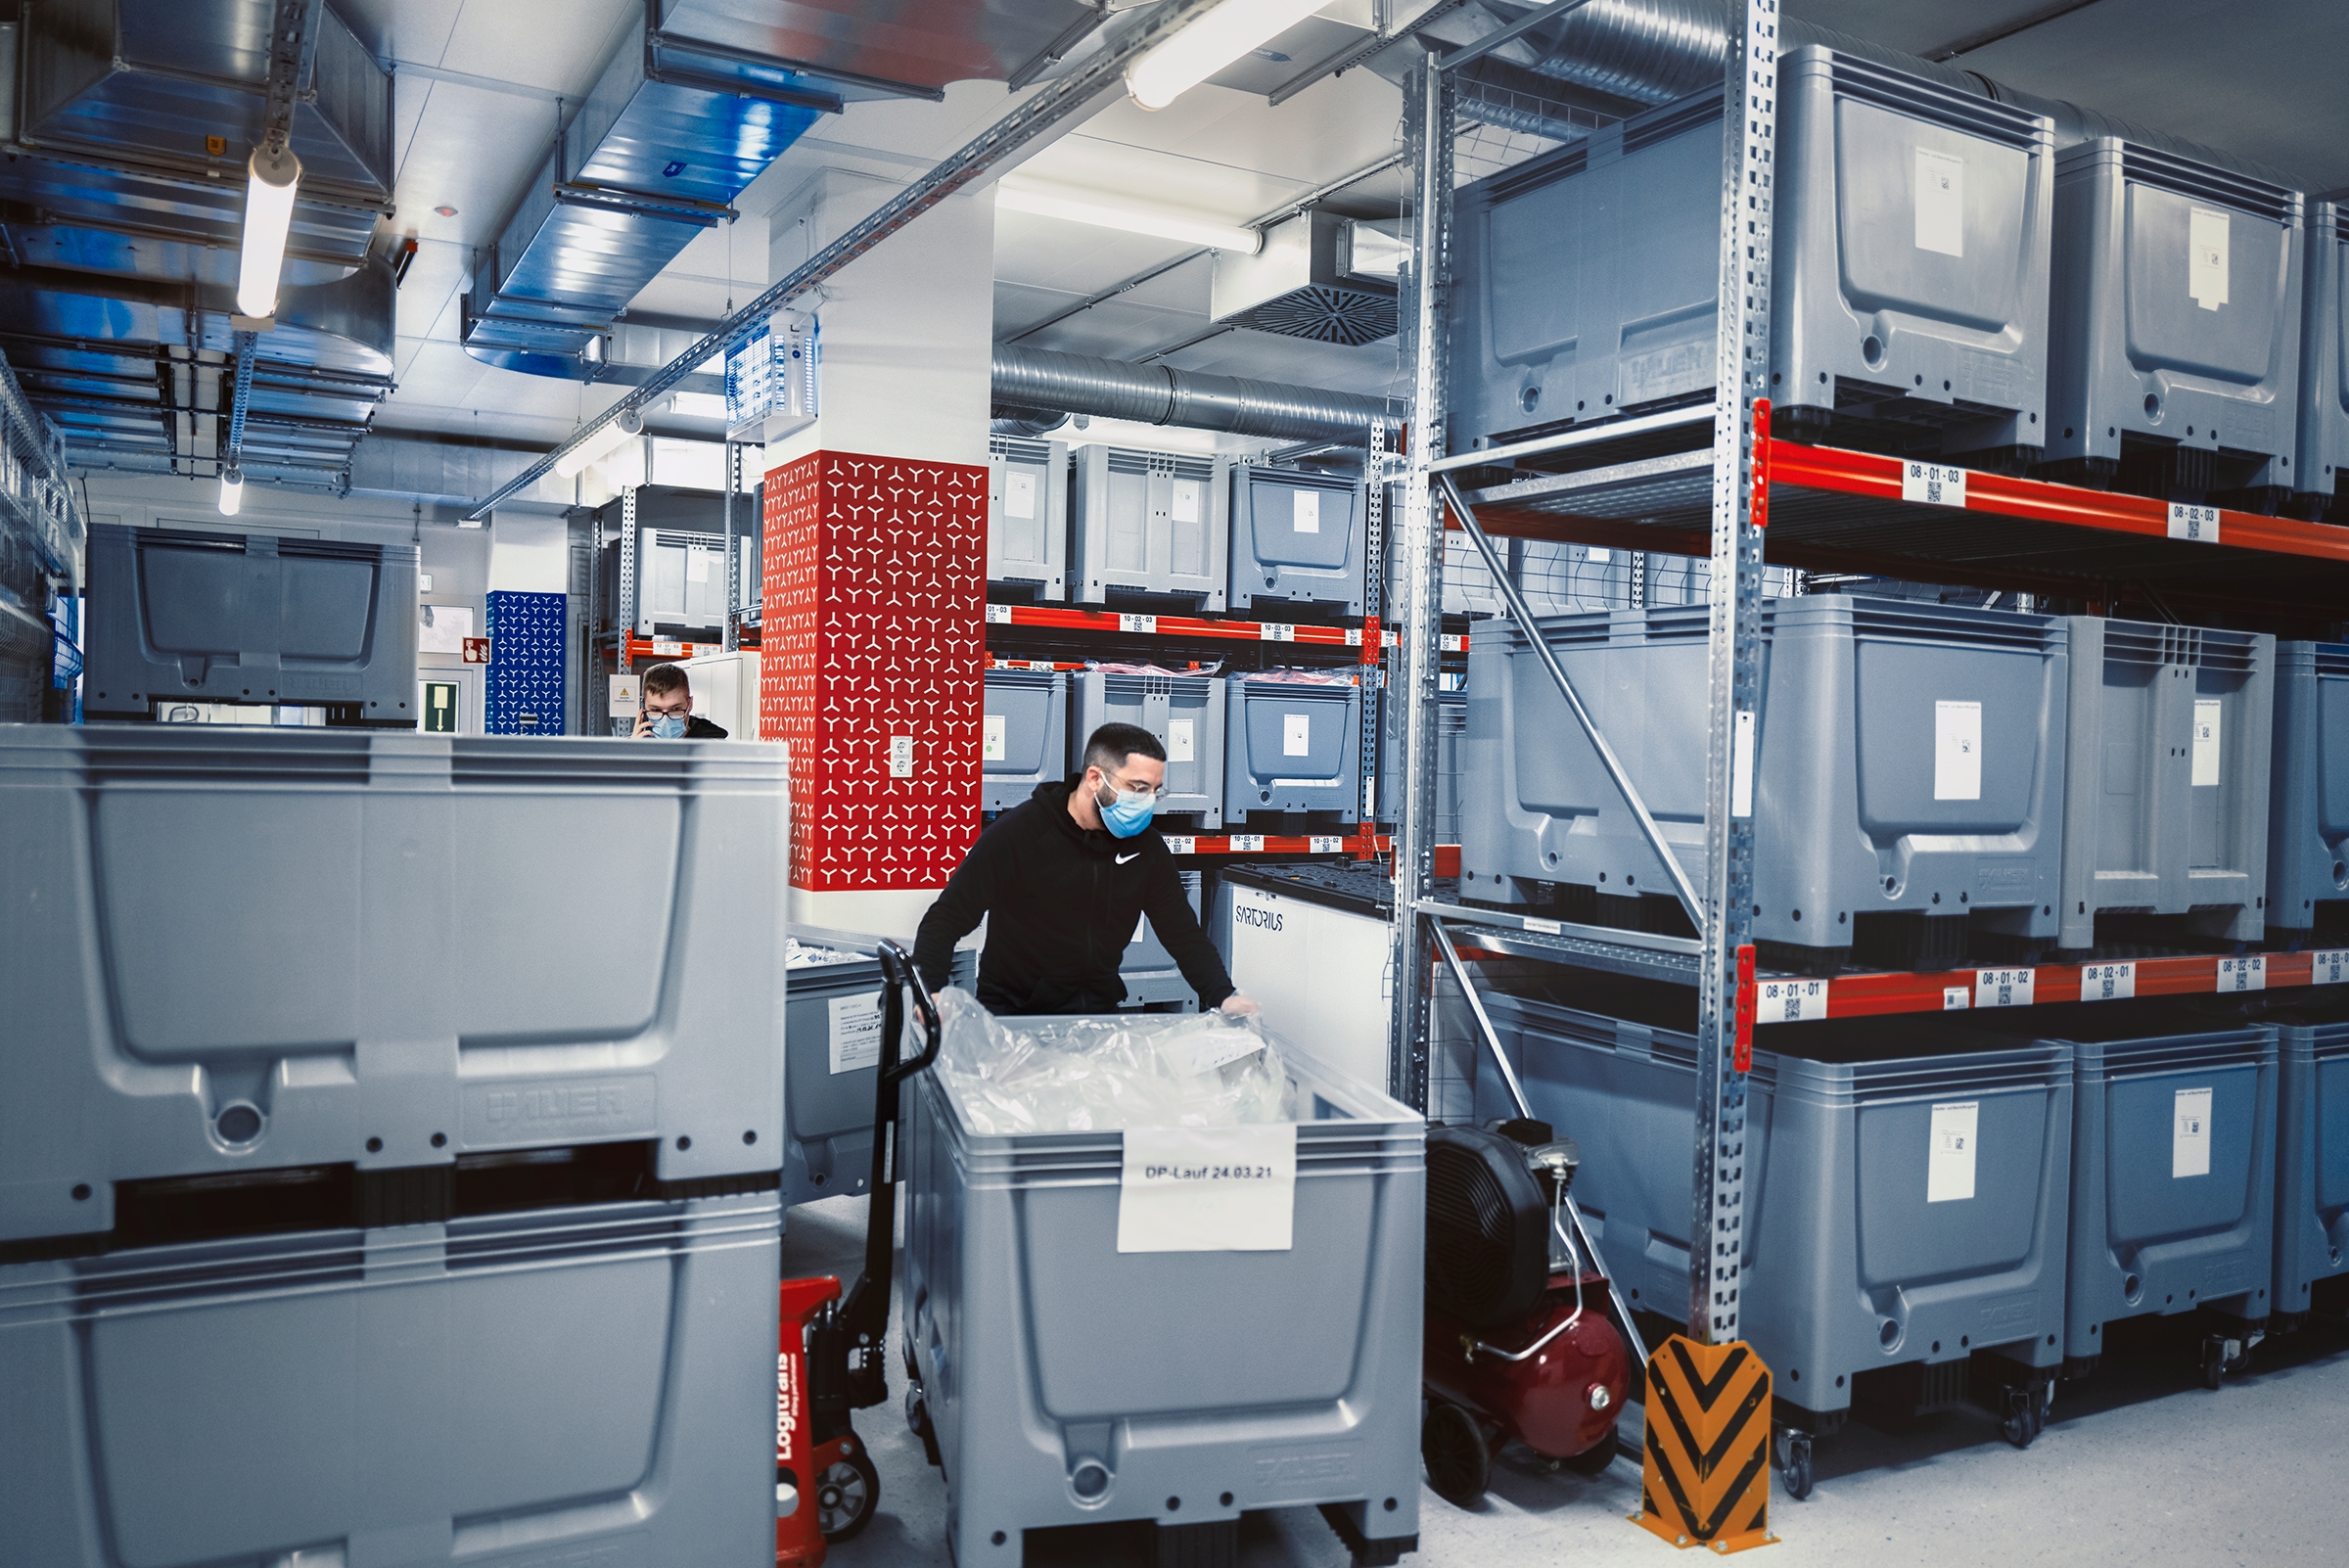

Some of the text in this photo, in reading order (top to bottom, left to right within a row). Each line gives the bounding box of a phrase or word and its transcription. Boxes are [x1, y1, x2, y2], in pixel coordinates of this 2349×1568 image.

[1911, 464, 1921, 478] 08
[1929, 467, 1939, 480] 01
[1948, 470, 1959, 483] 03
[2174, 506, 2184, 518] 08
[2189, 508, 2198, 520] 02
[2205, 510, 2214, 521] 03
[1235, 905, 1283, 932] SARTORIUS
[2223, 960, 2233, 972] 08
[2237, 959, 2246, 971] 02
[2252, 959, 2261, 970] 02
[2318, 953, 2326, 964] 08
[2331, 953, 2339, 963] 03
[1983, 972, 1994, 985] 08
[2001, 971, 2011, 984] 01
[2018, 971, 2028, 984] 02
[2088, 967, 2097, 979] 08
[2104, 966, 2113, 979] 02
[2120, 965, 2129, 978] 01
[1766, 985, 1778, 998] 08
[1787, 983, 1799, 996] 01
[1808, 982, 1819, 995] 01
[1145, 1166, 1272, 1179] DP-Lauf 24.03.21
[777, 1353, 797, 1460] Logitrans
